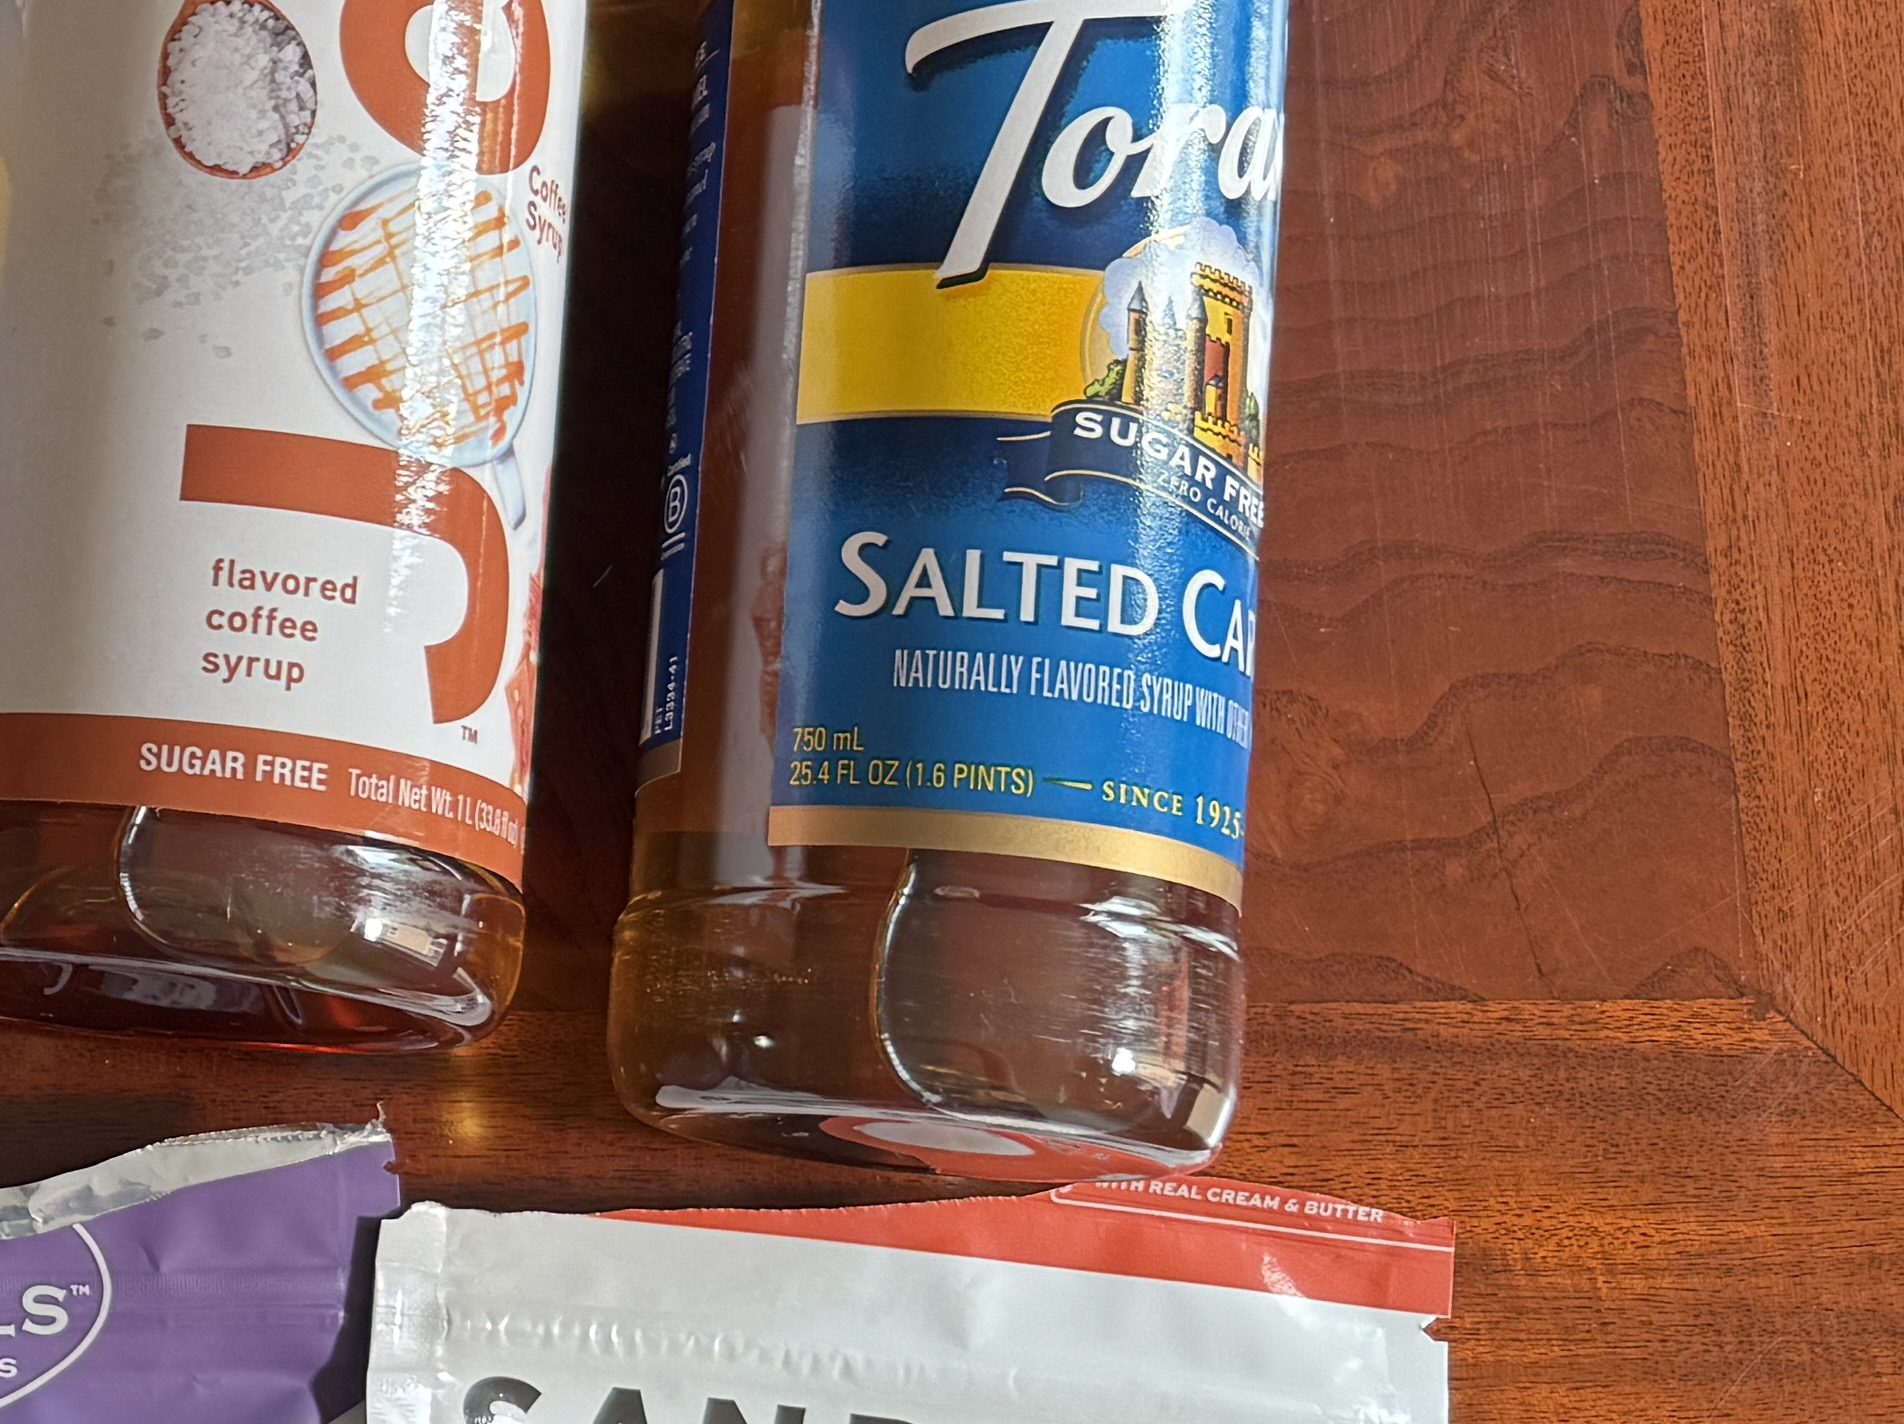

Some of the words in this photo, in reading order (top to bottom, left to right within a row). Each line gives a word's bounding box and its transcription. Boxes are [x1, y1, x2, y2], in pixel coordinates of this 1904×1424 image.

[212, 558, 358, 605] flavored
[834, 531, 1159, 637] SALTED
[205, 604, 318, 644] coffee
[201, 650, 305, 688] syrup
[893, 648, 1021, 694] NATURALLY
[1031, 657, 1135, 709] FLAVORED
[1140, 671, 1191, 720] SYRUP
[792, 727, 826, 752] 750
[832, 727, 864, 751] mL
[140, 743, 244, 780] SUGAR
[255, 754, 328, 792] FREE
[790, 760, 830, 786] 25.4
[836, 762, 859, 786] FL
[868, 761, 898, 786] OZ
[906, 761, 944, 789] (1.6
[952, 763, 1034, 797] PINTS)
[1149, 1181, 1200, 1200] REAL
[1207, 1187, 1280, 1211] CREAM
[1284, 1198, 1299, 1212] &
[1304, 1201, 1383, 1224] BUTTER
